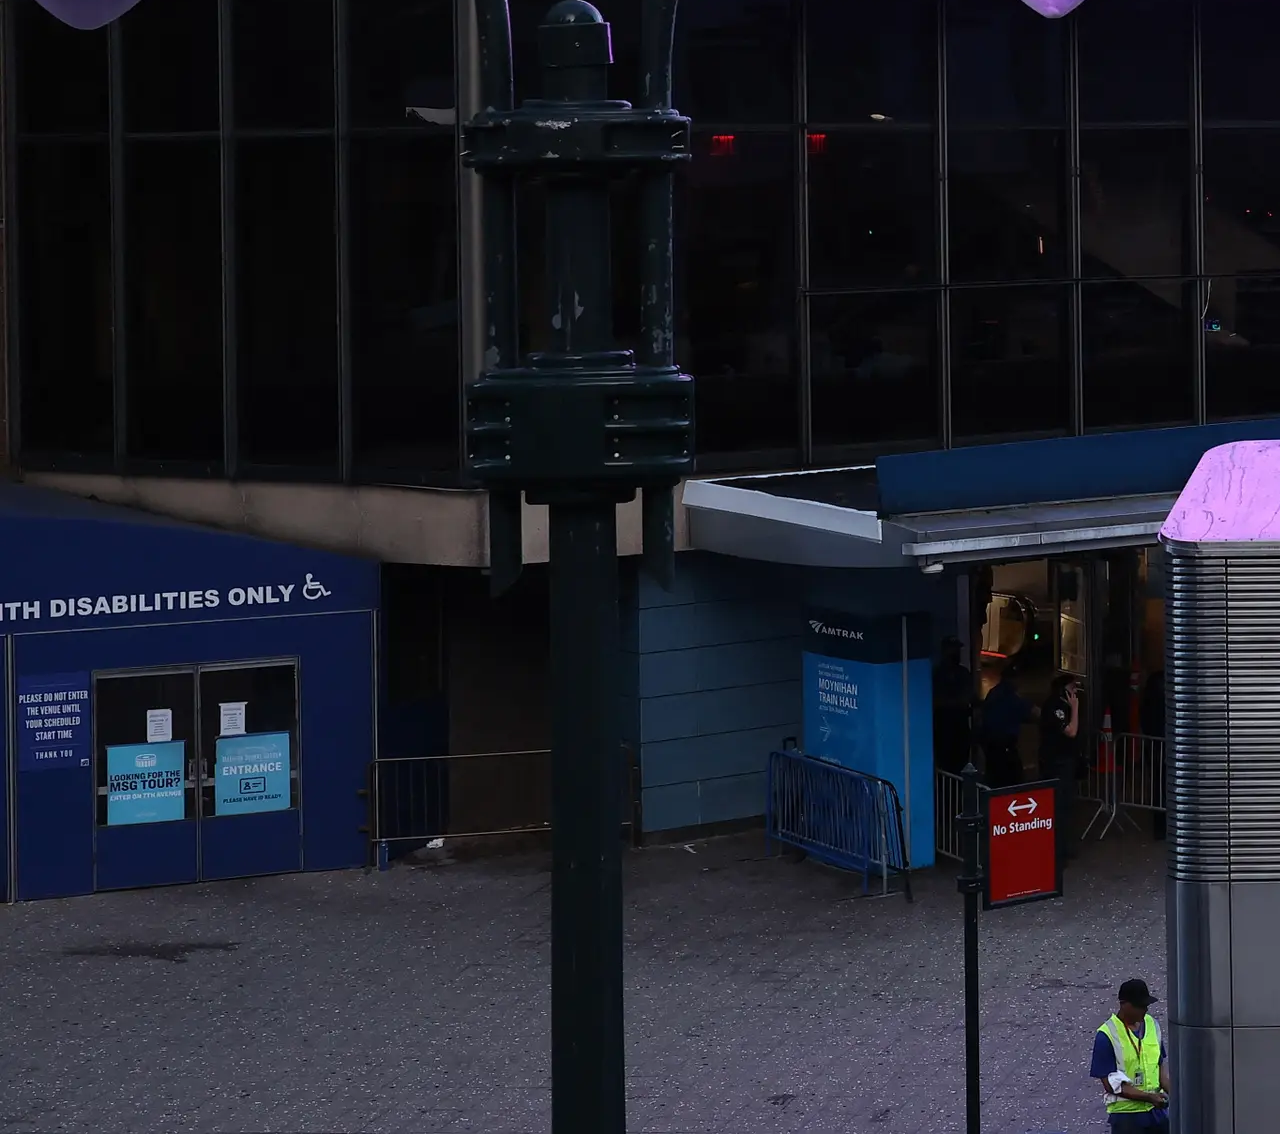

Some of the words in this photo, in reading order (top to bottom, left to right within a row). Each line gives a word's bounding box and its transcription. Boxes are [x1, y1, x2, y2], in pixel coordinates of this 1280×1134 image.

[0, 600, 41, 621] ITH
[50, 589, 220, 618] DISABILITIES
[227, 583, 295, 606] ONLY
[820, 626, 864, 641] AMTRAK
[818, 678, 858, 696] MOYNIHAN
[18, 693, 43, 704] PLEASE
[43, 692, 53, 702] DO
[53, 691, 67, 701] NOT
[68, 690, 89, 700] ENTER
[818, 691, 839, 706] TRAIN
[840, 695, 858, 710] HALL
[26, 706, 40, 716] THE
[40, 704, 61, 715] VENUE
[62, 703, 81, 713] UNTIL
[25, 719, 43, 729] YOUR
[43, 716, 81, 728] SCHEDULED
[35, 731, 56, 741] START
[57, 729, 73, 739] TIME
[35, 750, 58, 760] THANK
[59, 749, 73, 758] YOU
[109, 772, 146, 782] LOOKING
[147, 771, 163, 779] FOR
[164, 770, 181, 778] THE
[222, 762, 282, 776] ENTRANCE
[109, 781, 138, 792] MSG
[141, 777, 181, 790] TOUR?
[110, 794, 131, 802] ENTER
[156, 789, 182, 797] AVENUE
[223, 796, 239, 804] PLEASE
[992, 824, 1007, 836] No
[1009, 817, 1053, 834] Standing
